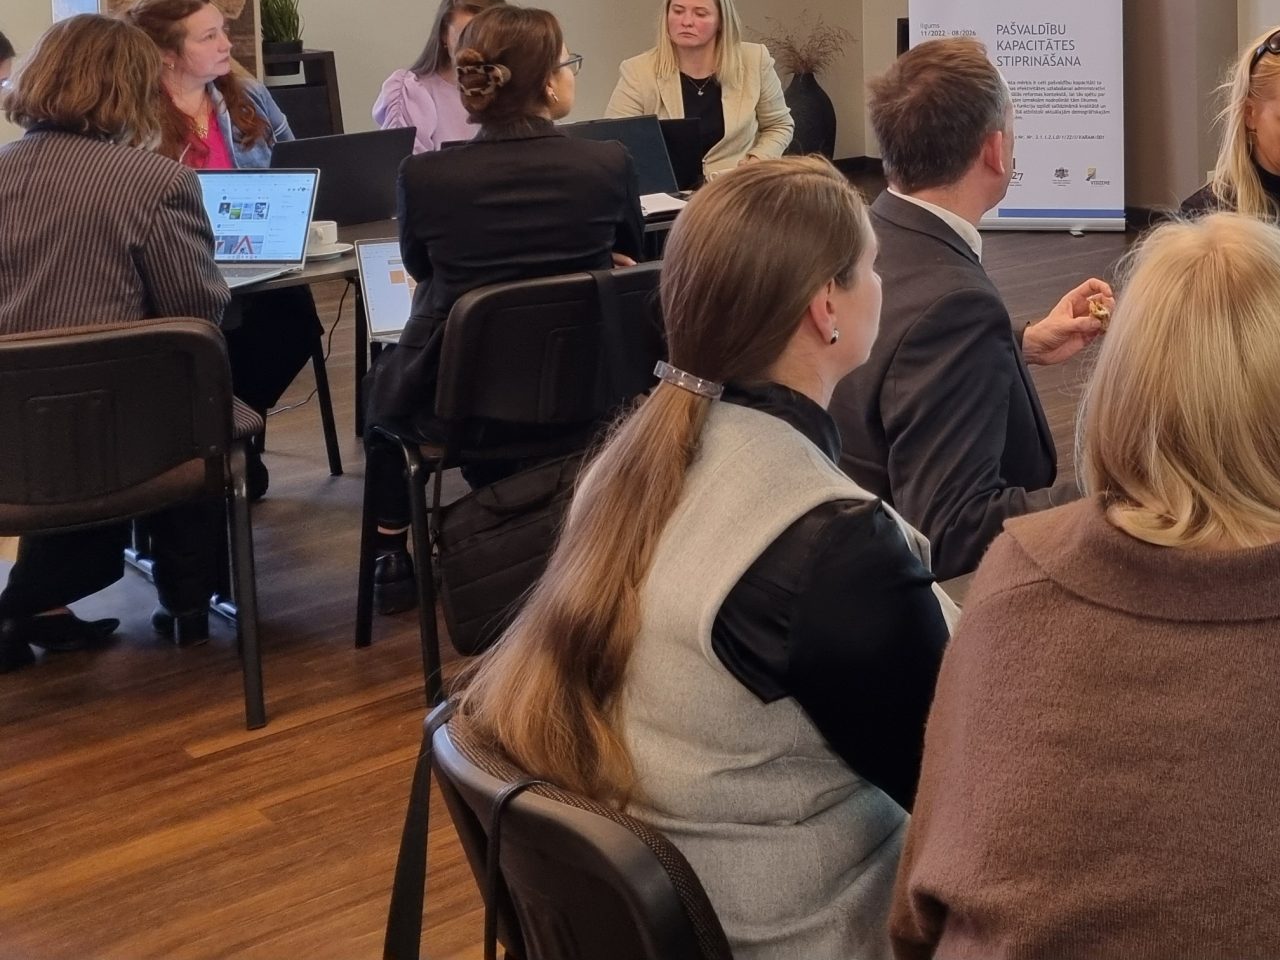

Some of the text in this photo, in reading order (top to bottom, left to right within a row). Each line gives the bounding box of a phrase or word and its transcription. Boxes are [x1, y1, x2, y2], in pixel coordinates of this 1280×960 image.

[996, 21, 1067, 35] PAŠVALDĪBU
[996, 38, 1076, 51] KAPACITĀTES
[996, 53, 1082, 67] STIPRINĀŠANA
